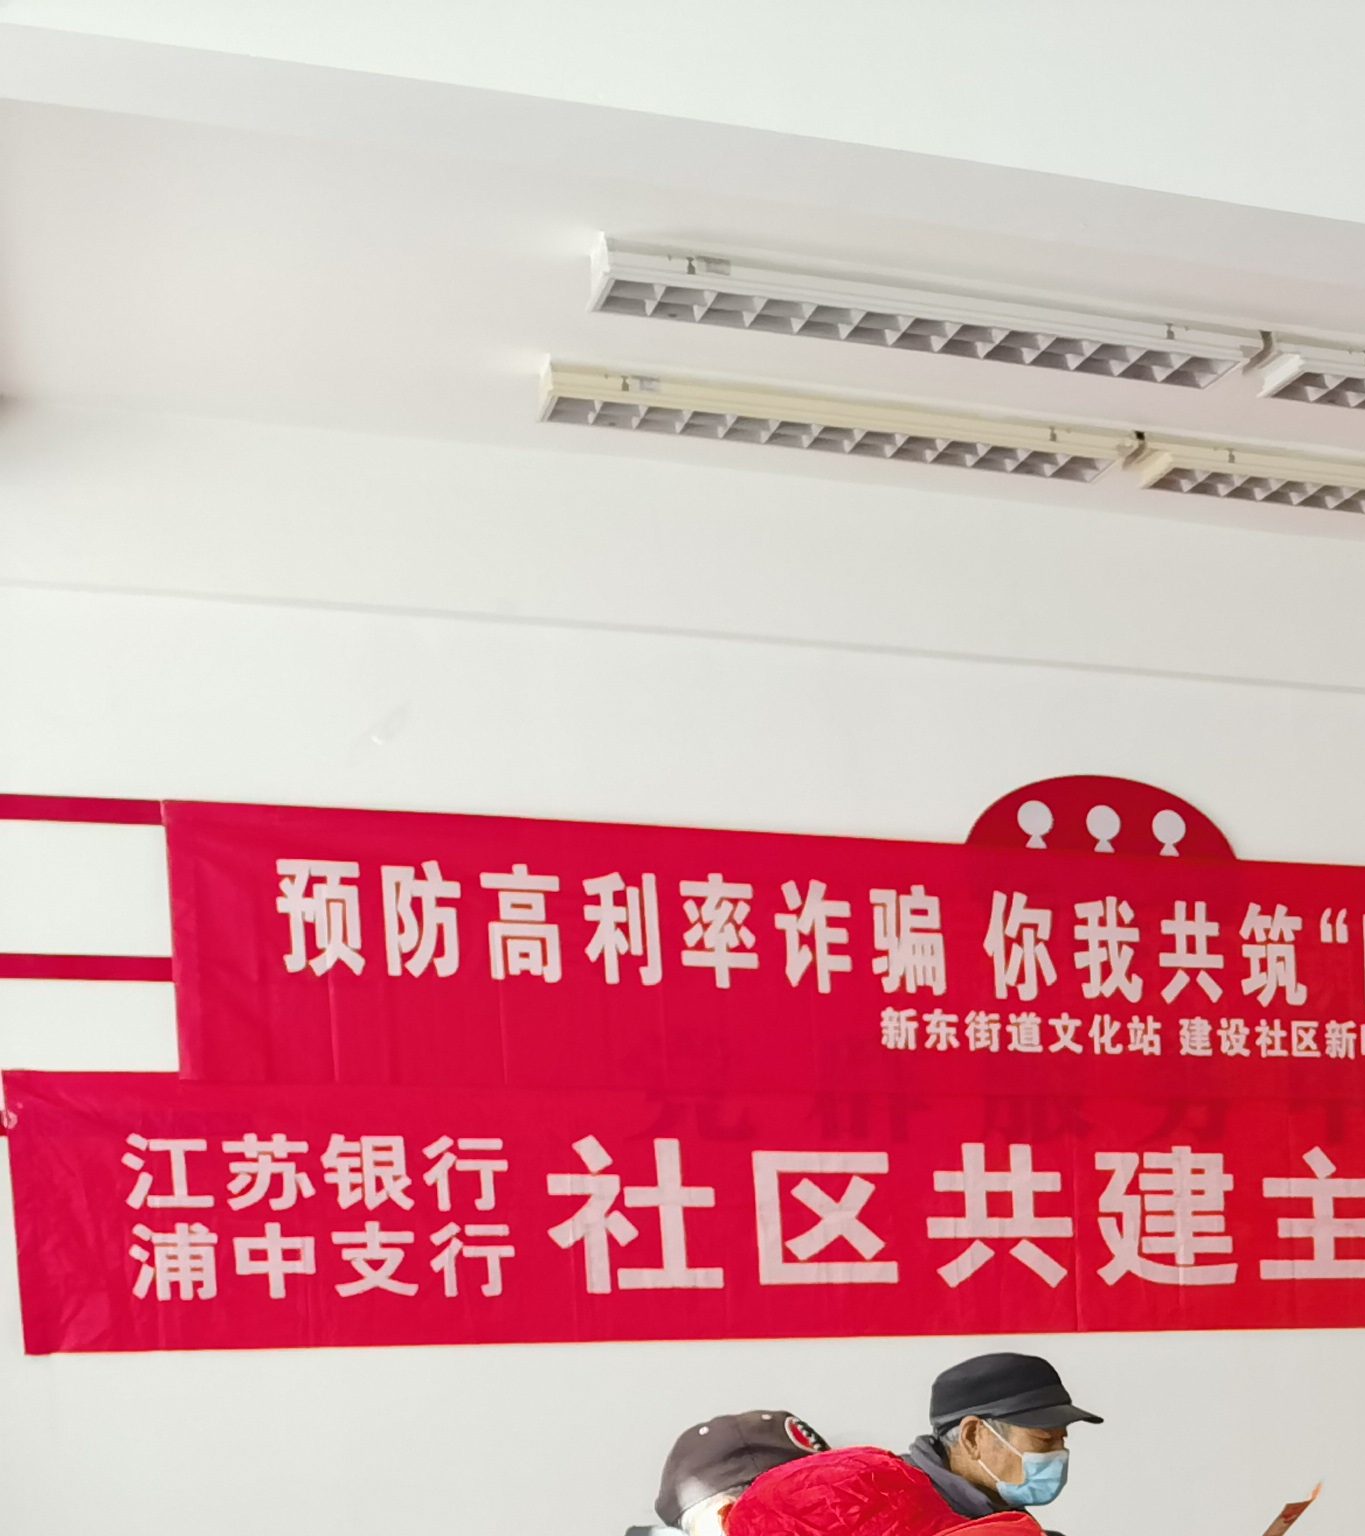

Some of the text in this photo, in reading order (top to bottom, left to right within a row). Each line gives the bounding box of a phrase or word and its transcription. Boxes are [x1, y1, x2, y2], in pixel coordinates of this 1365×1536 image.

[276, 858, 947, 996] 预防高利率诈骗
[880, 1006, 1162, 1056] 新东街道文化站
[121, 1133, 509, 1212] 江苏银行
[129, 1221, 515, 1301] 浦中支行
